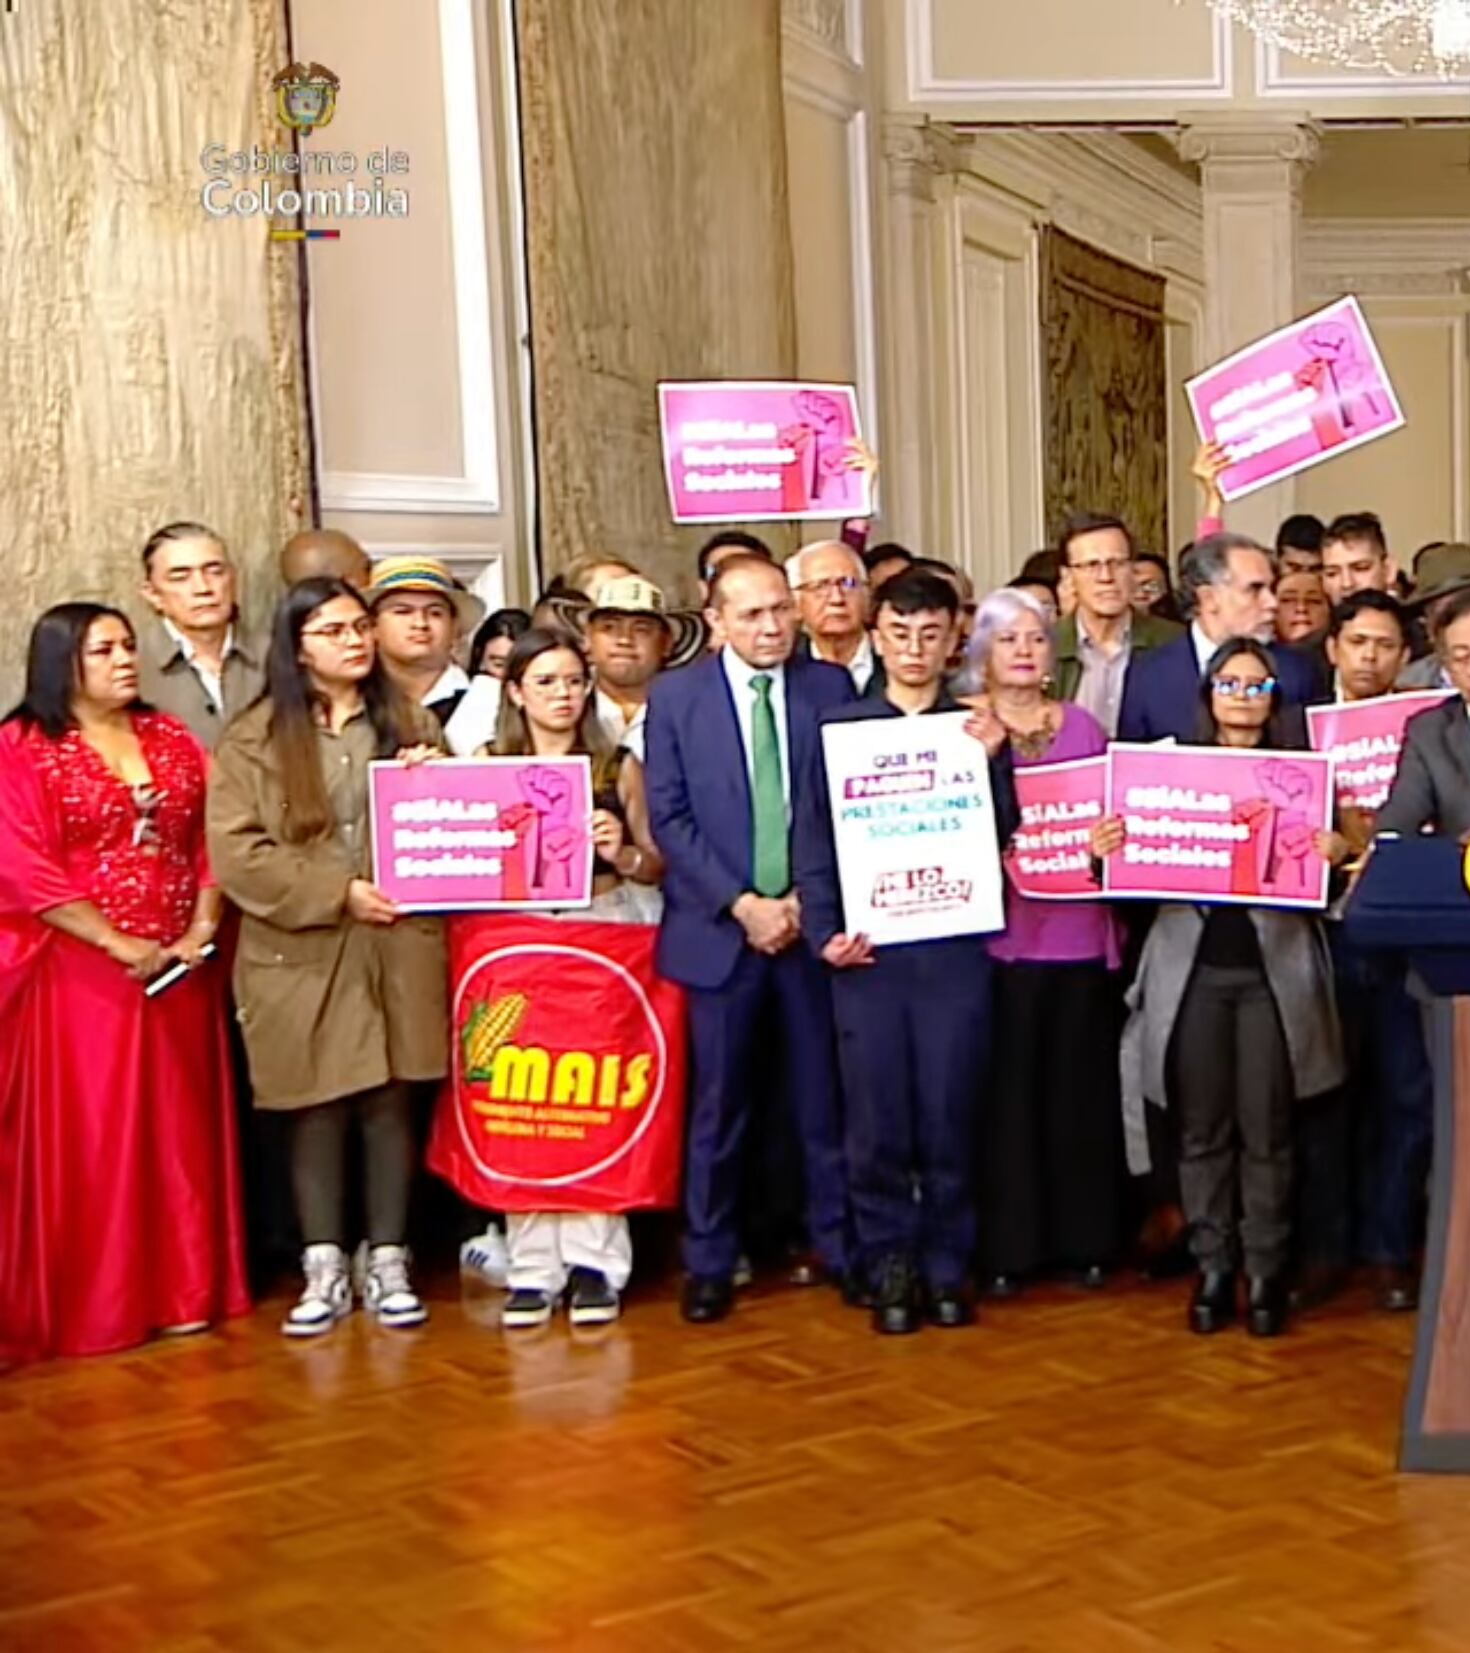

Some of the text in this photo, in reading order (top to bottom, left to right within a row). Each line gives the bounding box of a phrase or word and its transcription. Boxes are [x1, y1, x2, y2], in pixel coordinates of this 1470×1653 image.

[873, 752, 908, 769] QUE
[1336, 762, 1397, 789] Refo
[841, 794, 983, 820] PRESTACIONES
[868, 816, 963, 839] SOCIALES
[1125, 815, 1249, 840] Reformas
[1018, 849, 1090, 875] Social
[1124, 843, 1231, 867] Sociales
[489, 1044, 651, 1109] MAIS
